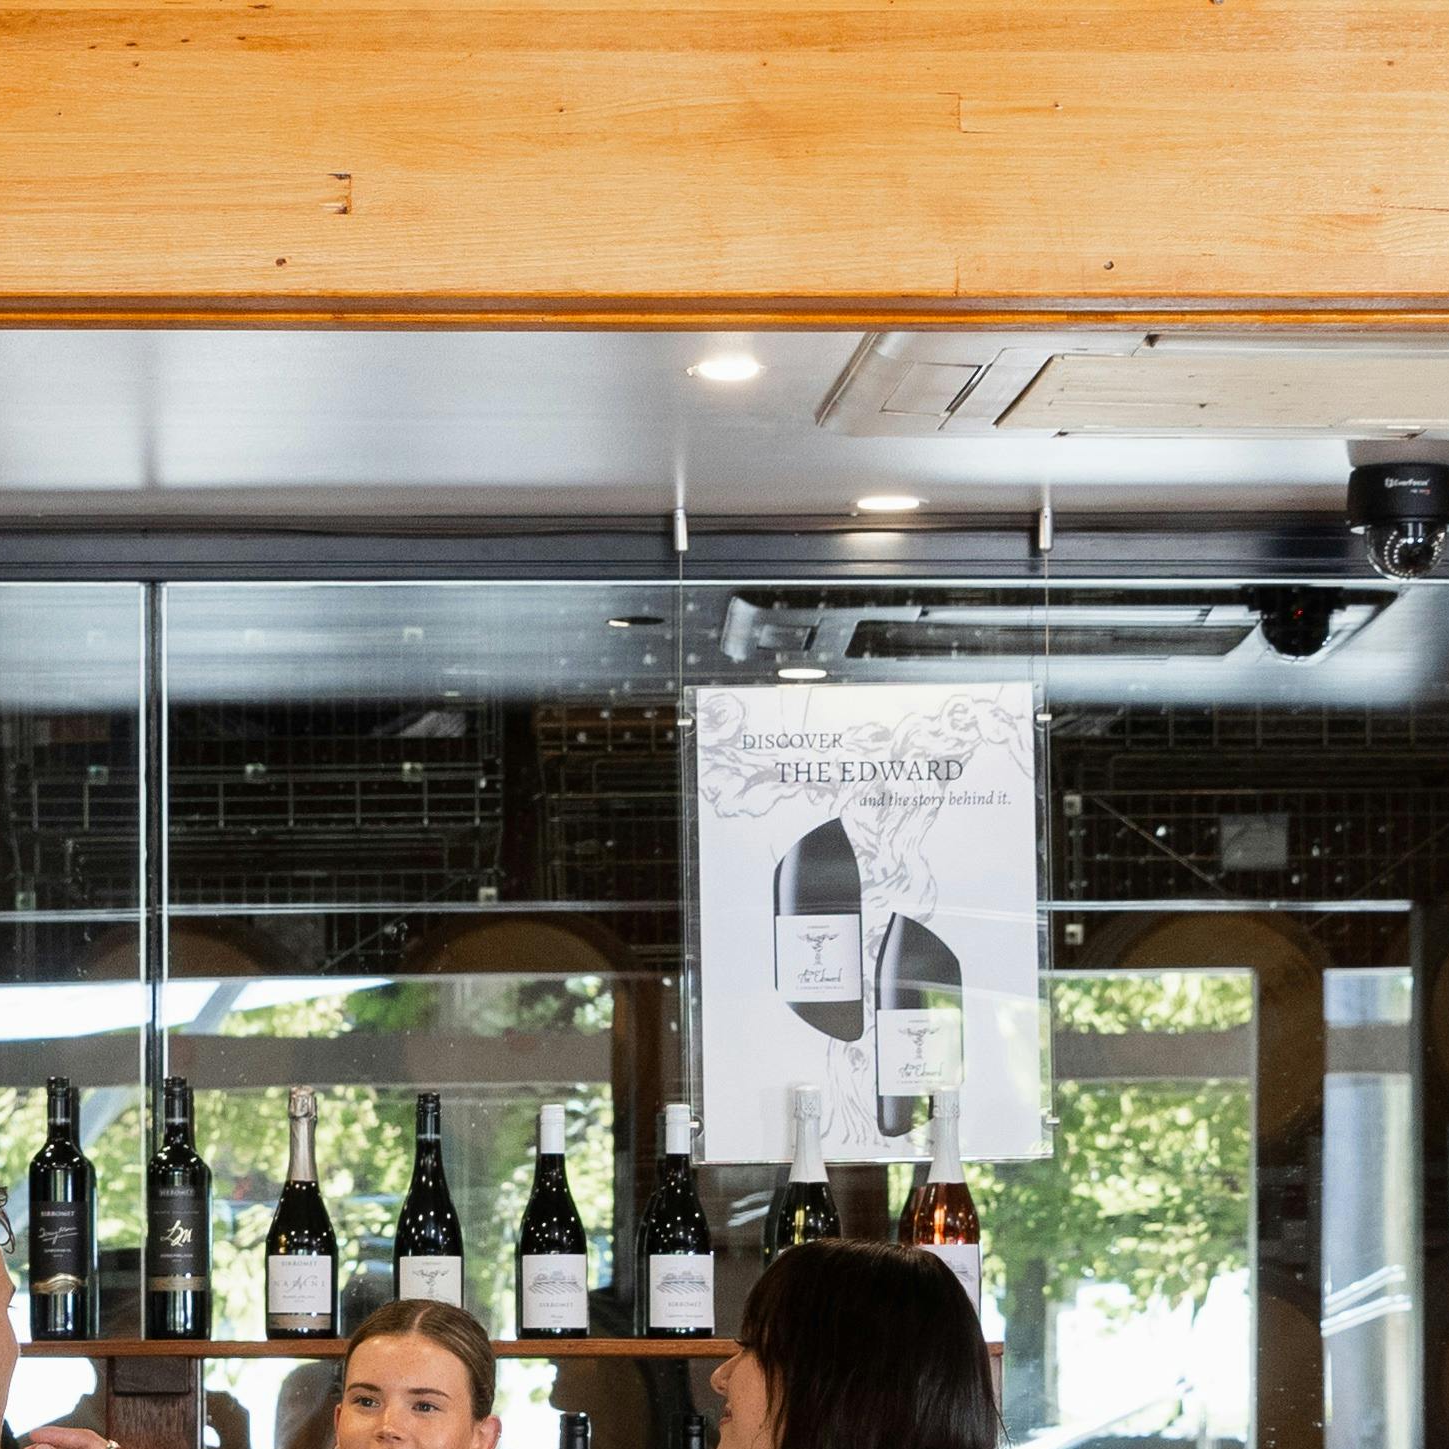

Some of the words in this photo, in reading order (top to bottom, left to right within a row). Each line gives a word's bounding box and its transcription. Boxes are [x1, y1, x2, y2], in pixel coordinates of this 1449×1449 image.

[743, 734, 844, 750] DISCOVER
[775, 761, 832, 783] THE
[840, 760, 965, 783] EDWARD
[859, 792, 886, 807] and
[889, 792, 910, 806] the
[911, 795, 945, 810] story
[949, 791, 993, 806] behind
